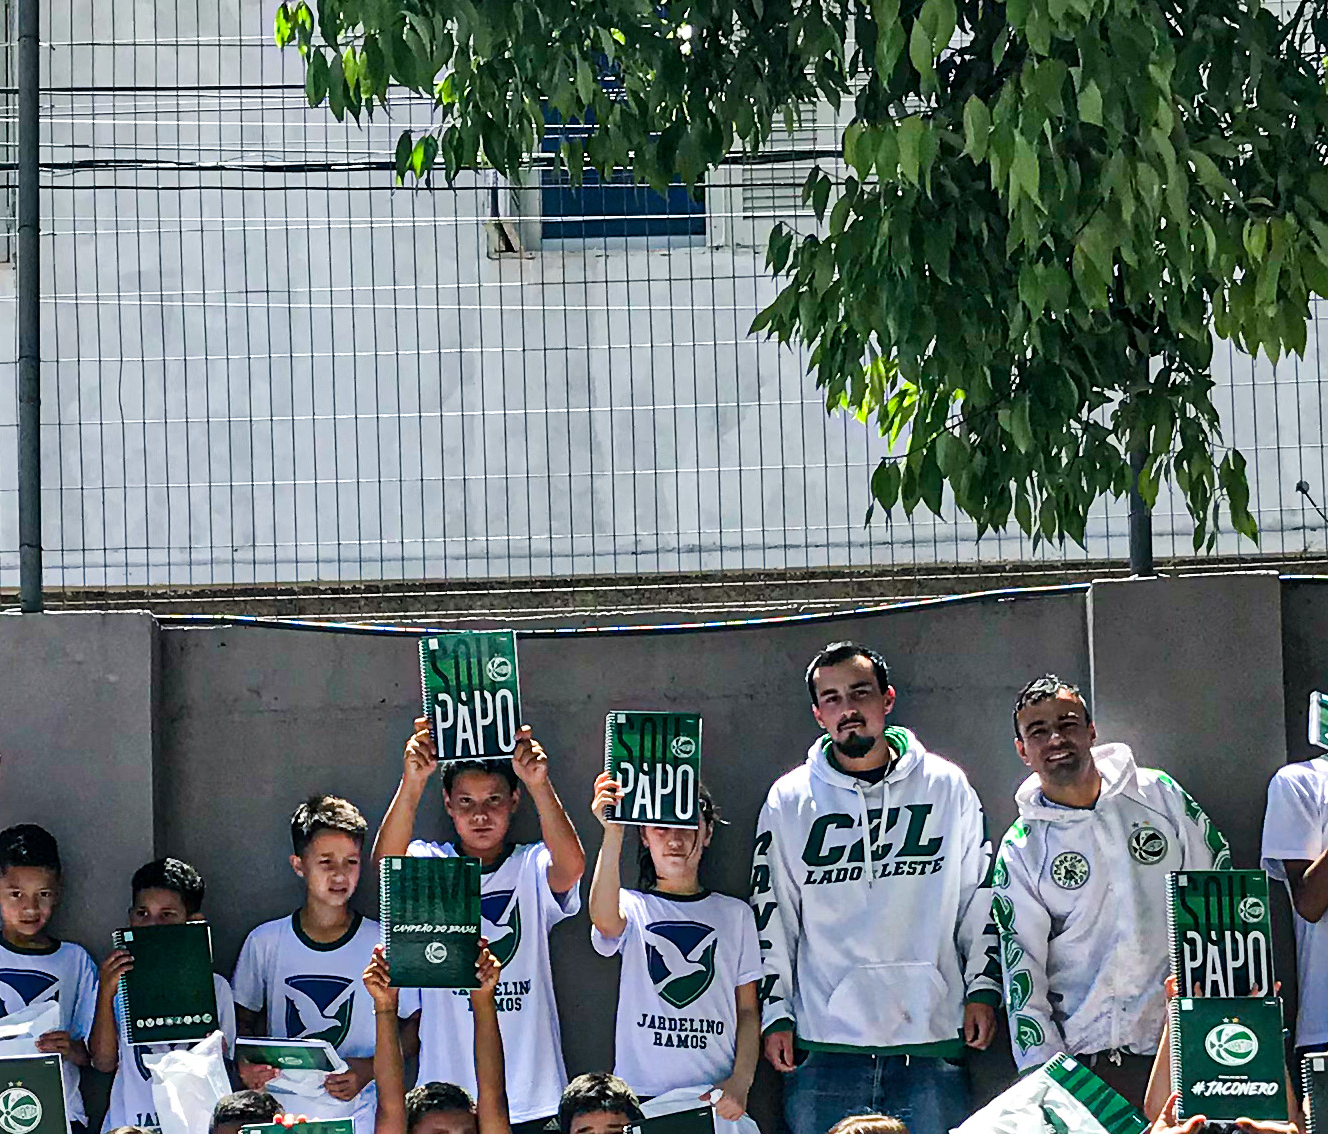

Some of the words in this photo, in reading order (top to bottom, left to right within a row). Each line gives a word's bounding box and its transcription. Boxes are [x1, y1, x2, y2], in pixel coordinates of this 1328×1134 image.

[435, 689, 516, 757] PAPO
[616, 762, 693, 820] PAPO
[801, 804, 944, 867] CZL
[804, 865, 864, 885] LADO
[880, 857, 944, 878] LESTE
[433, 924, 447, 934] DO
[446, 924, 477, 934] BRASIL
[1183, 930, 1269, 998] PAPO
[636, 1013, 724, 1035] JARDELINO
[653, 1031, 707, 1050] RAMOS
[1191, 1081, 1279, 1096] #JACONERO
